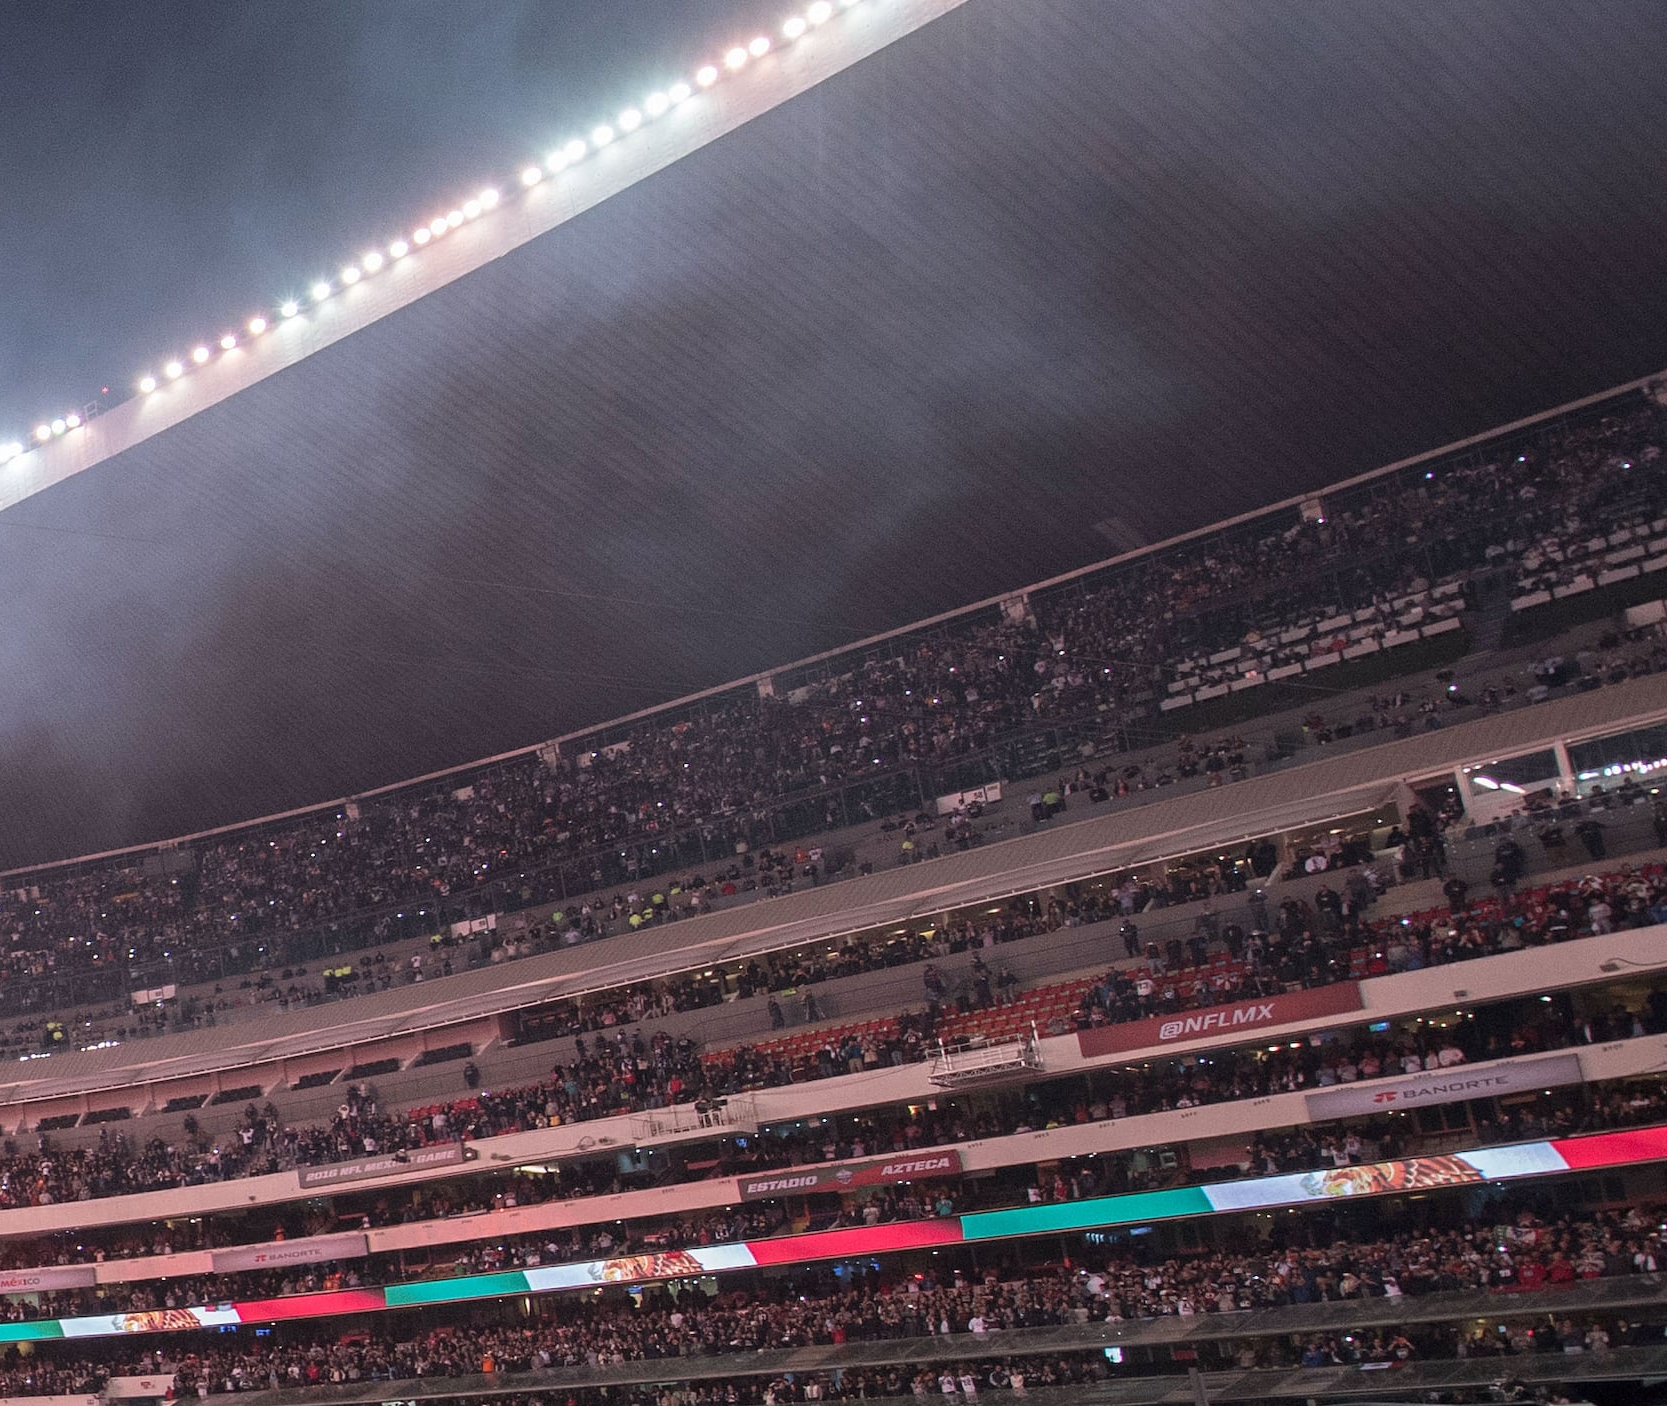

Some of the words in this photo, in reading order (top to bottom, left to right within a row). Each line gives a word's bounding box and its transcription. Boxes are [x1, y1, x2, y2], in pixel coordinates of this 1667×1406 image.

[1159, 1004, 1273, 1041] @NFLMX
[1402, 1075, 1510, 1099] BANORTE
[339, 1165, 363, 1177] NFL
[417, 1150, 456, 1164] GAME
[747, 1175, 818, 1194] ESTADIO
[880, 1157, 951, 1176] AZTECA
[268, 1248, 321, 1261] BANORTE
